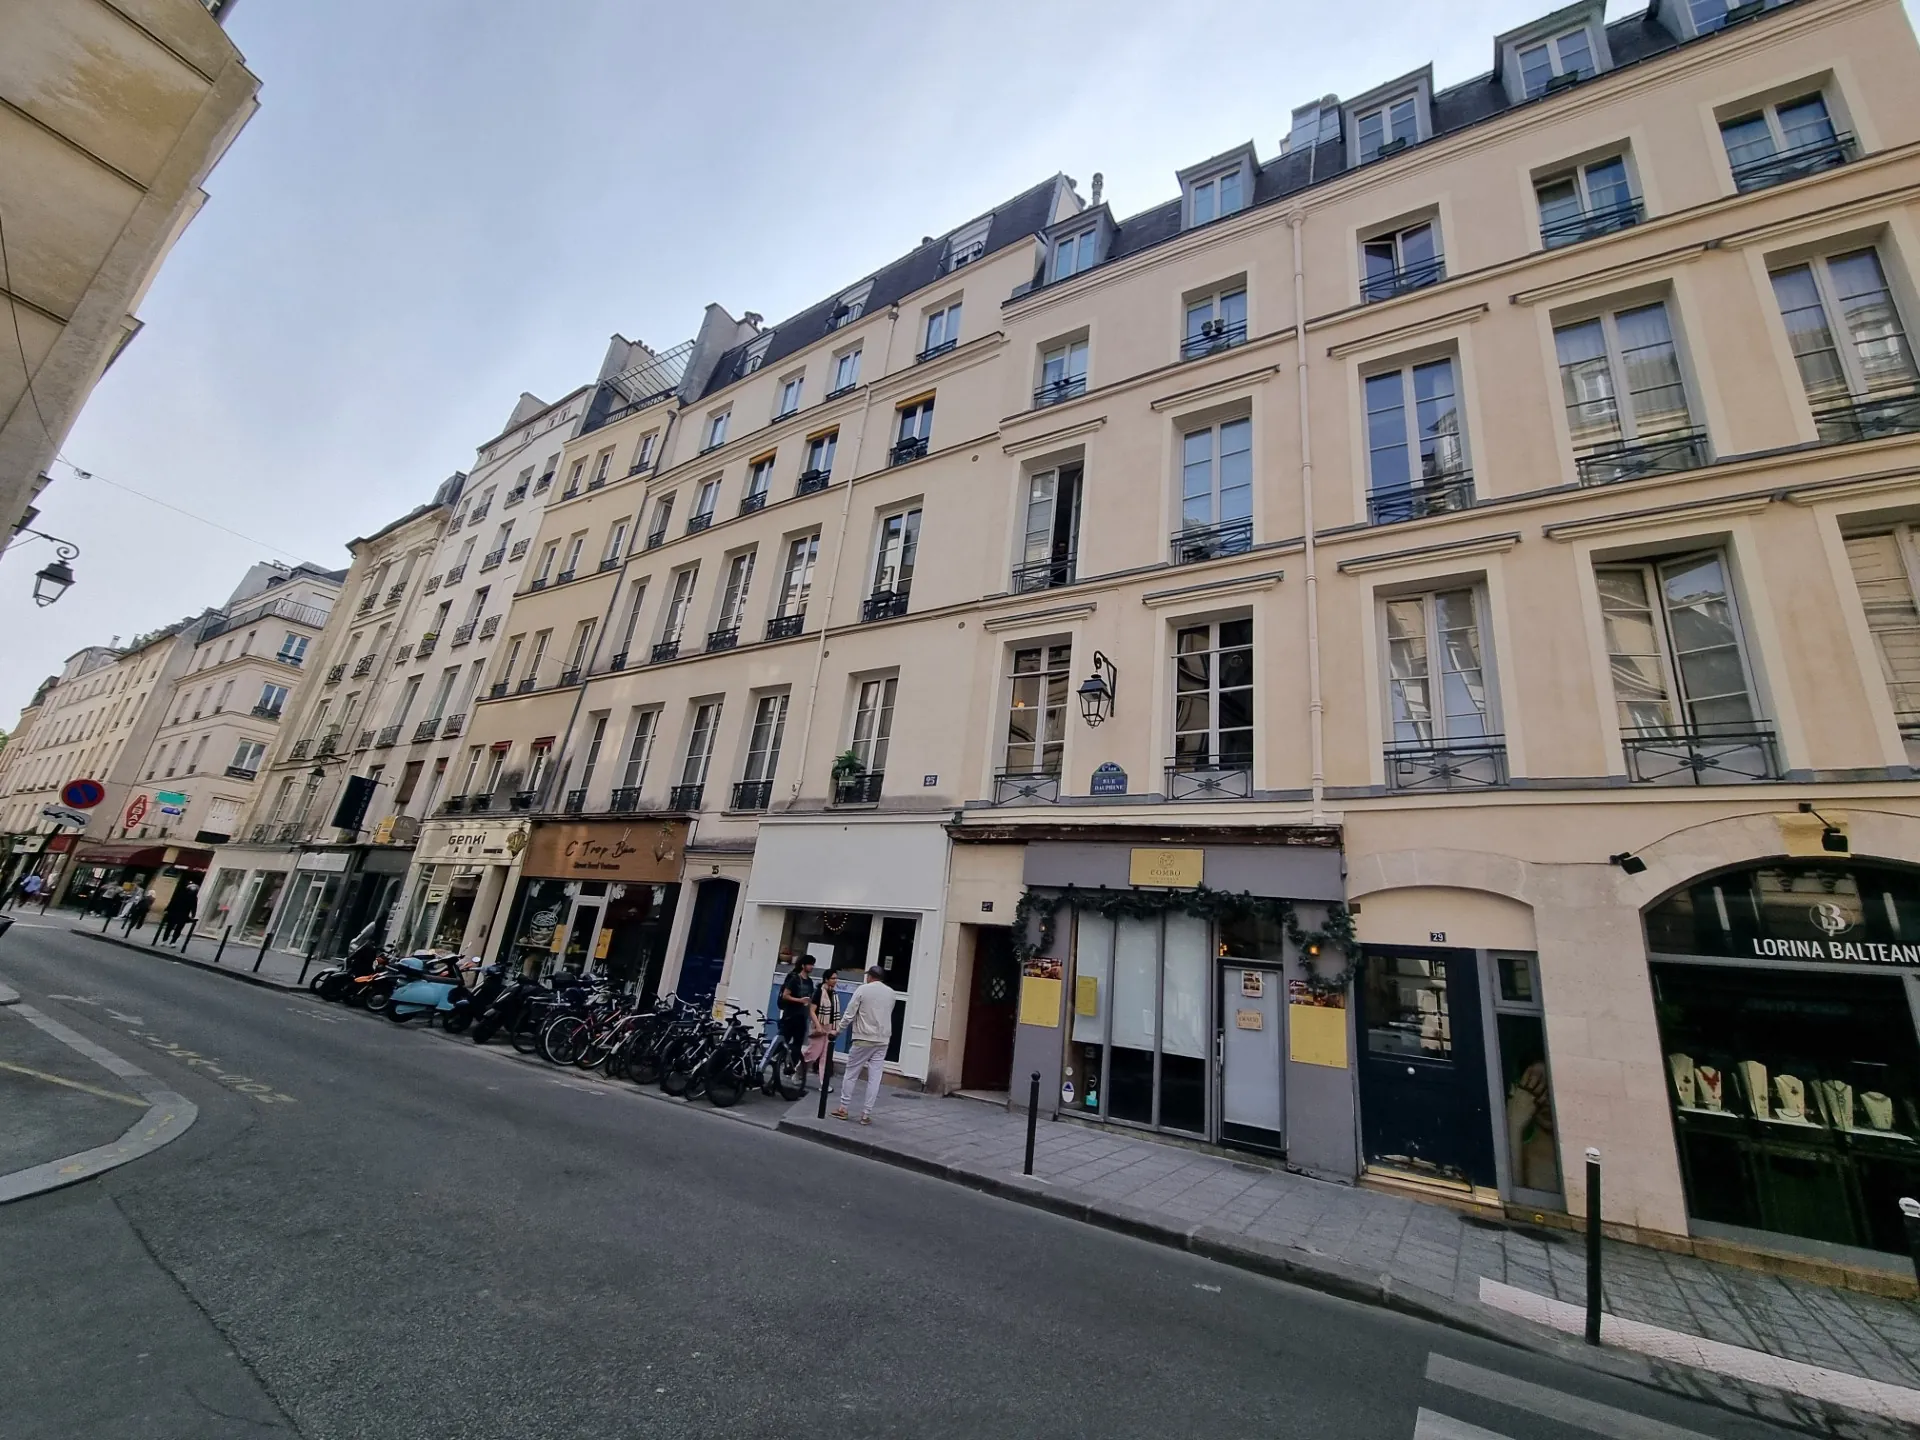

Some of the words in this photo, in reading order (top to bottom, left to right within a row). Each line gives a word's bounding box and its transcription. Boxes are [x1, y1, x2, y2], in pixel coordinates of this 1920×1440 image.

[128, 796, 146, 827] TABAC
[565, 840, 579, 857] C
[582, 840, 609, 859] Trop
[1150, 869, 1181, 877] COMBO
[1432, 933, 1444, 942] 29
[1752, 938, 1825, 959] LORINA
[1828, 941, 1920, 964] BALTEAN
